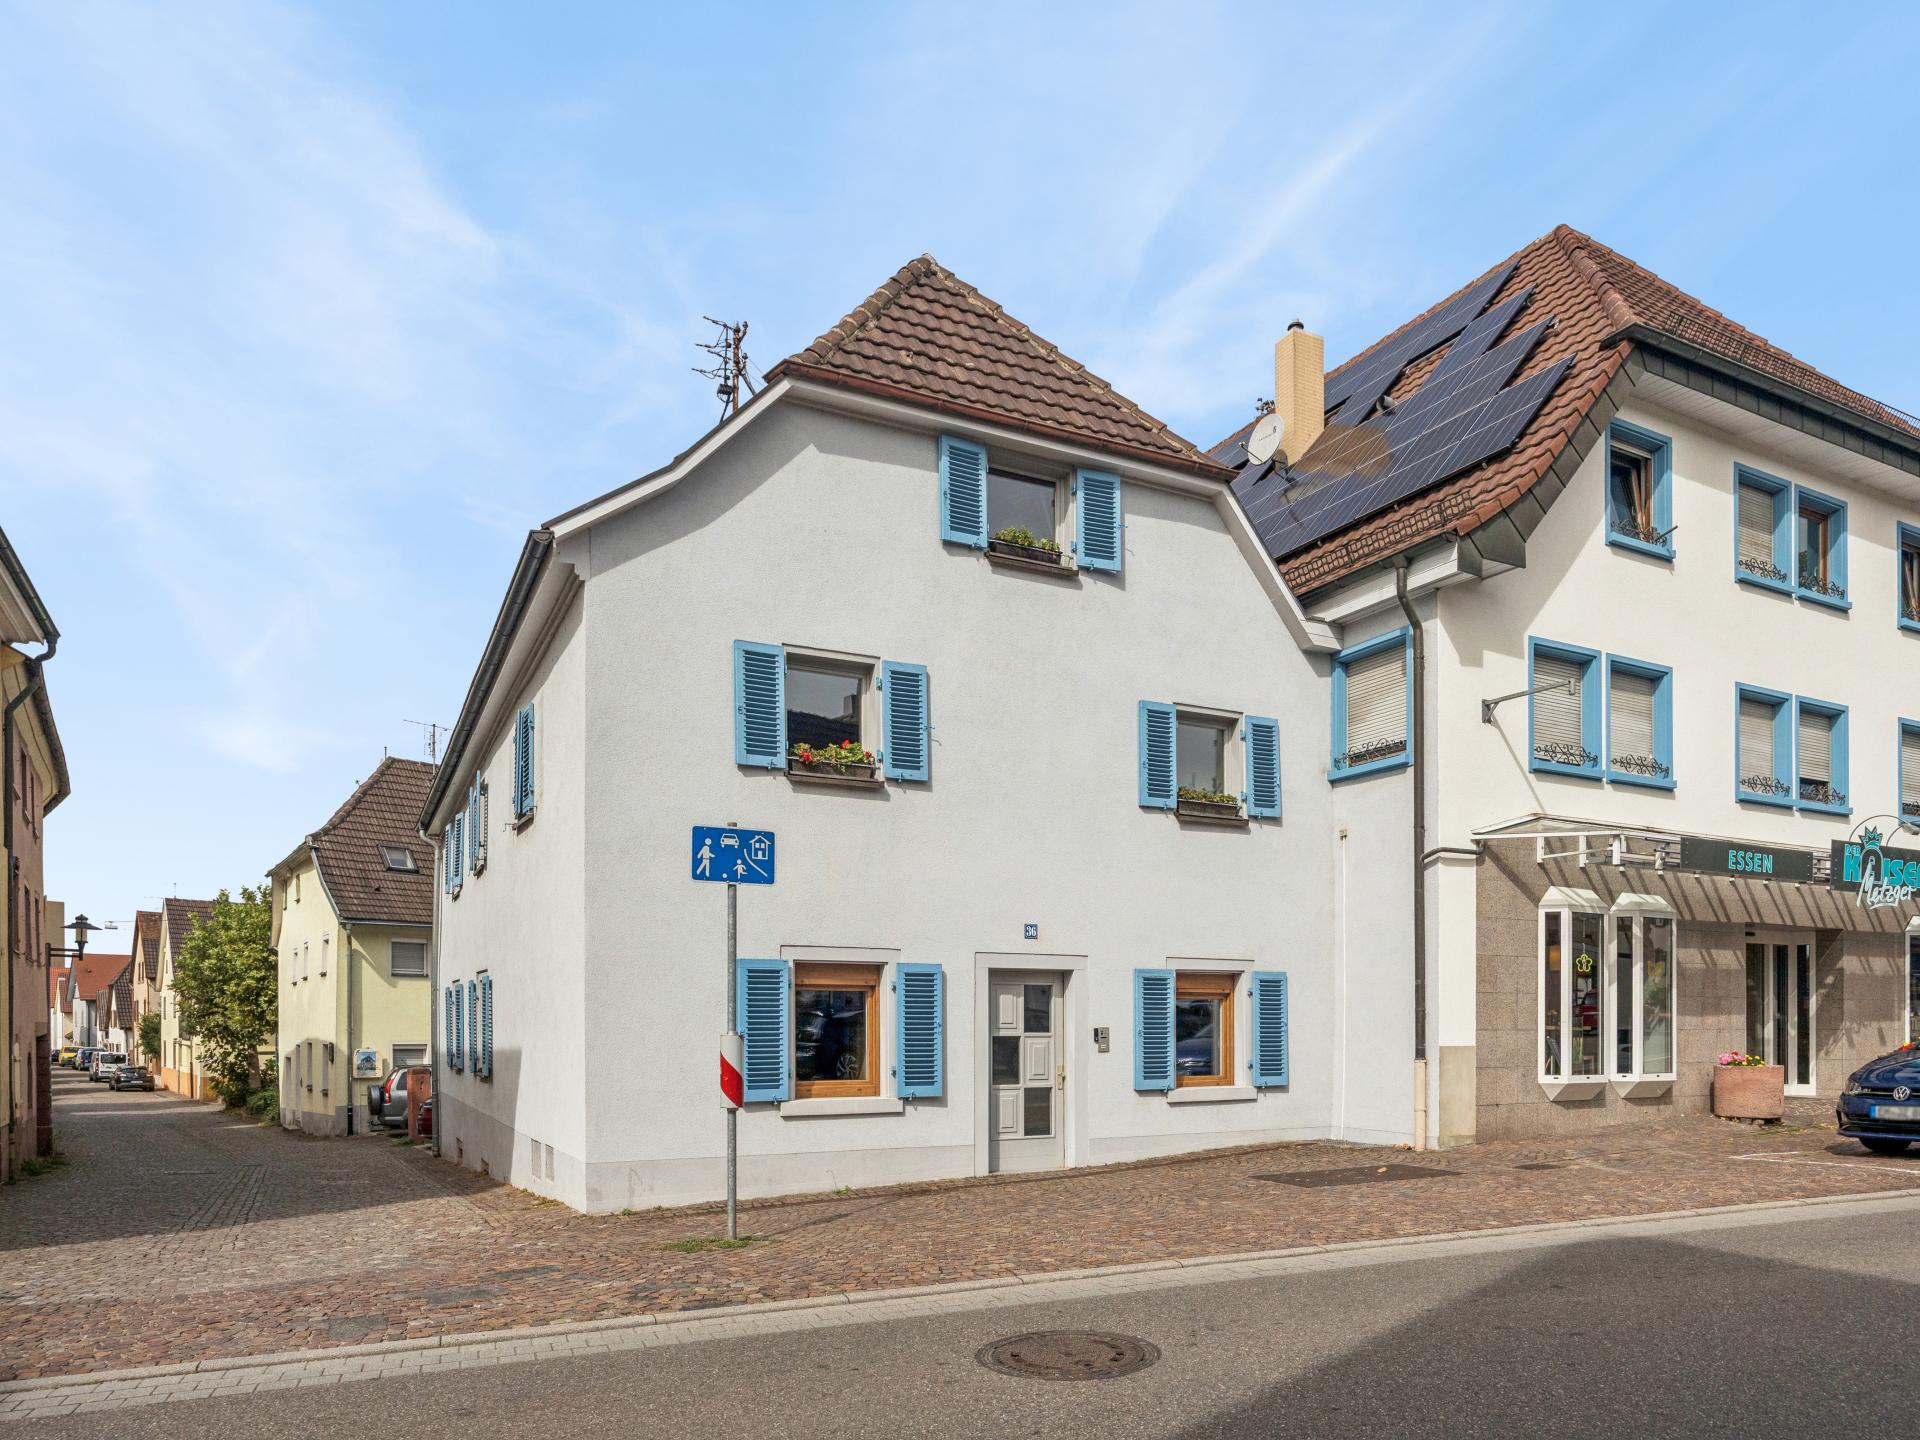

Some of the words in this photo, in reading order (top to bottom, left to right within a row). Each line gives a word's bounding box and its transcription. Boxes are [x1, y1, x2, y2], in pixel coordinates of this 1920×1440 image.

[1844, 843, 1861, 856] DER
[1728, 849, 1773, 873] ESSEN
[1857, 856, 1917, 909] Metzger
[1026, 925, 1037, 937] 36
